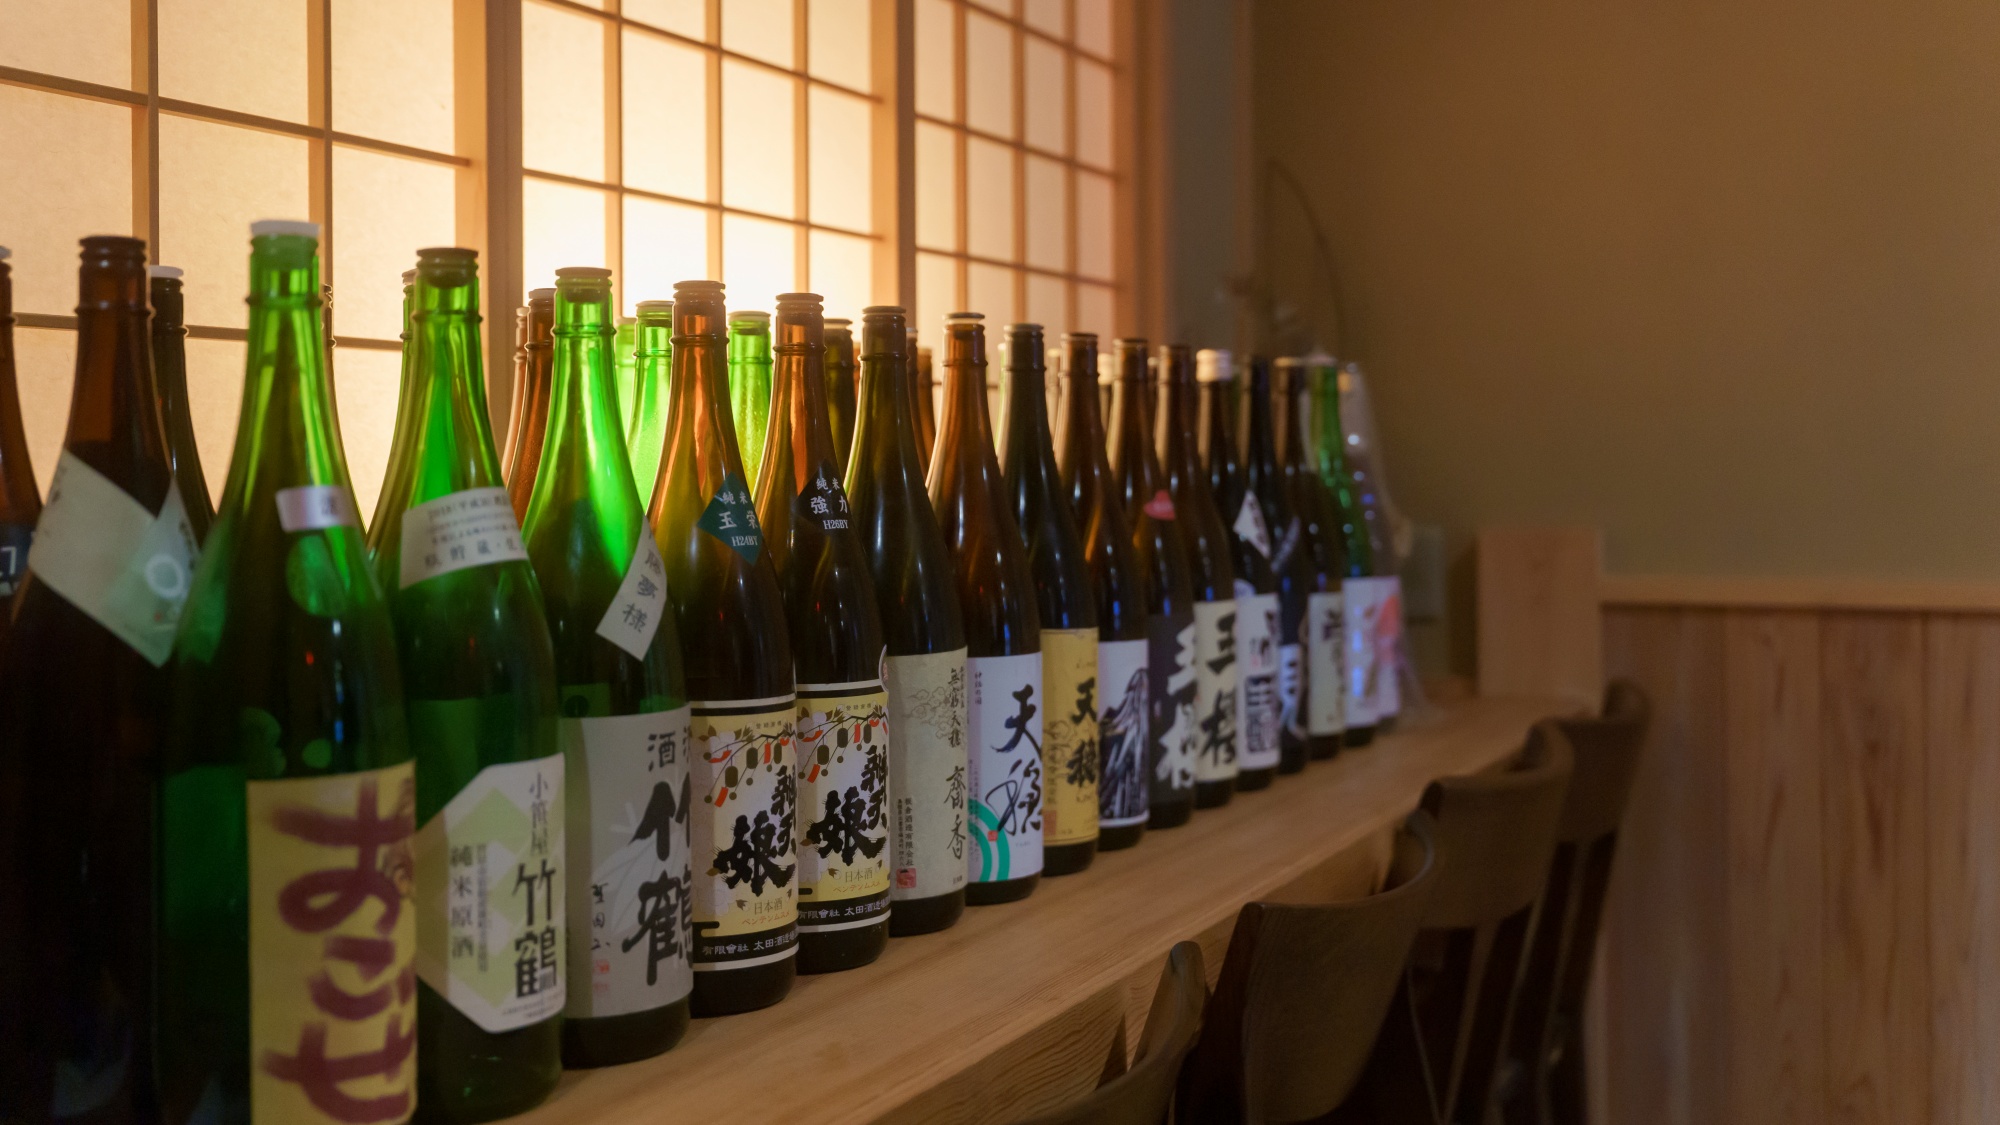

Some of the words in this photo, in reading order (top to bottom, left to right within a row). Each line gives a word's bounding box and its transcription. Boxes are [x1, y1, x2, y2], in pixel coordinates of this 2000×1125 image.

[816, 477, 841, 490] 純米
[722, 491, 748, 505] 純米
[809, 496, 848, 515] 強力
[718, 511, 759, 530] 玉栄
[823, 519, 849, 530] H26BY
[732, 535, 759, 547] H24BY
[845, 867, 873, 883] 日本酒
[451, 845, 474, 959] 純米原酒
[755, 897, 783, 915] 日本酒
[512, 858, 557, 999] 竹鶴
